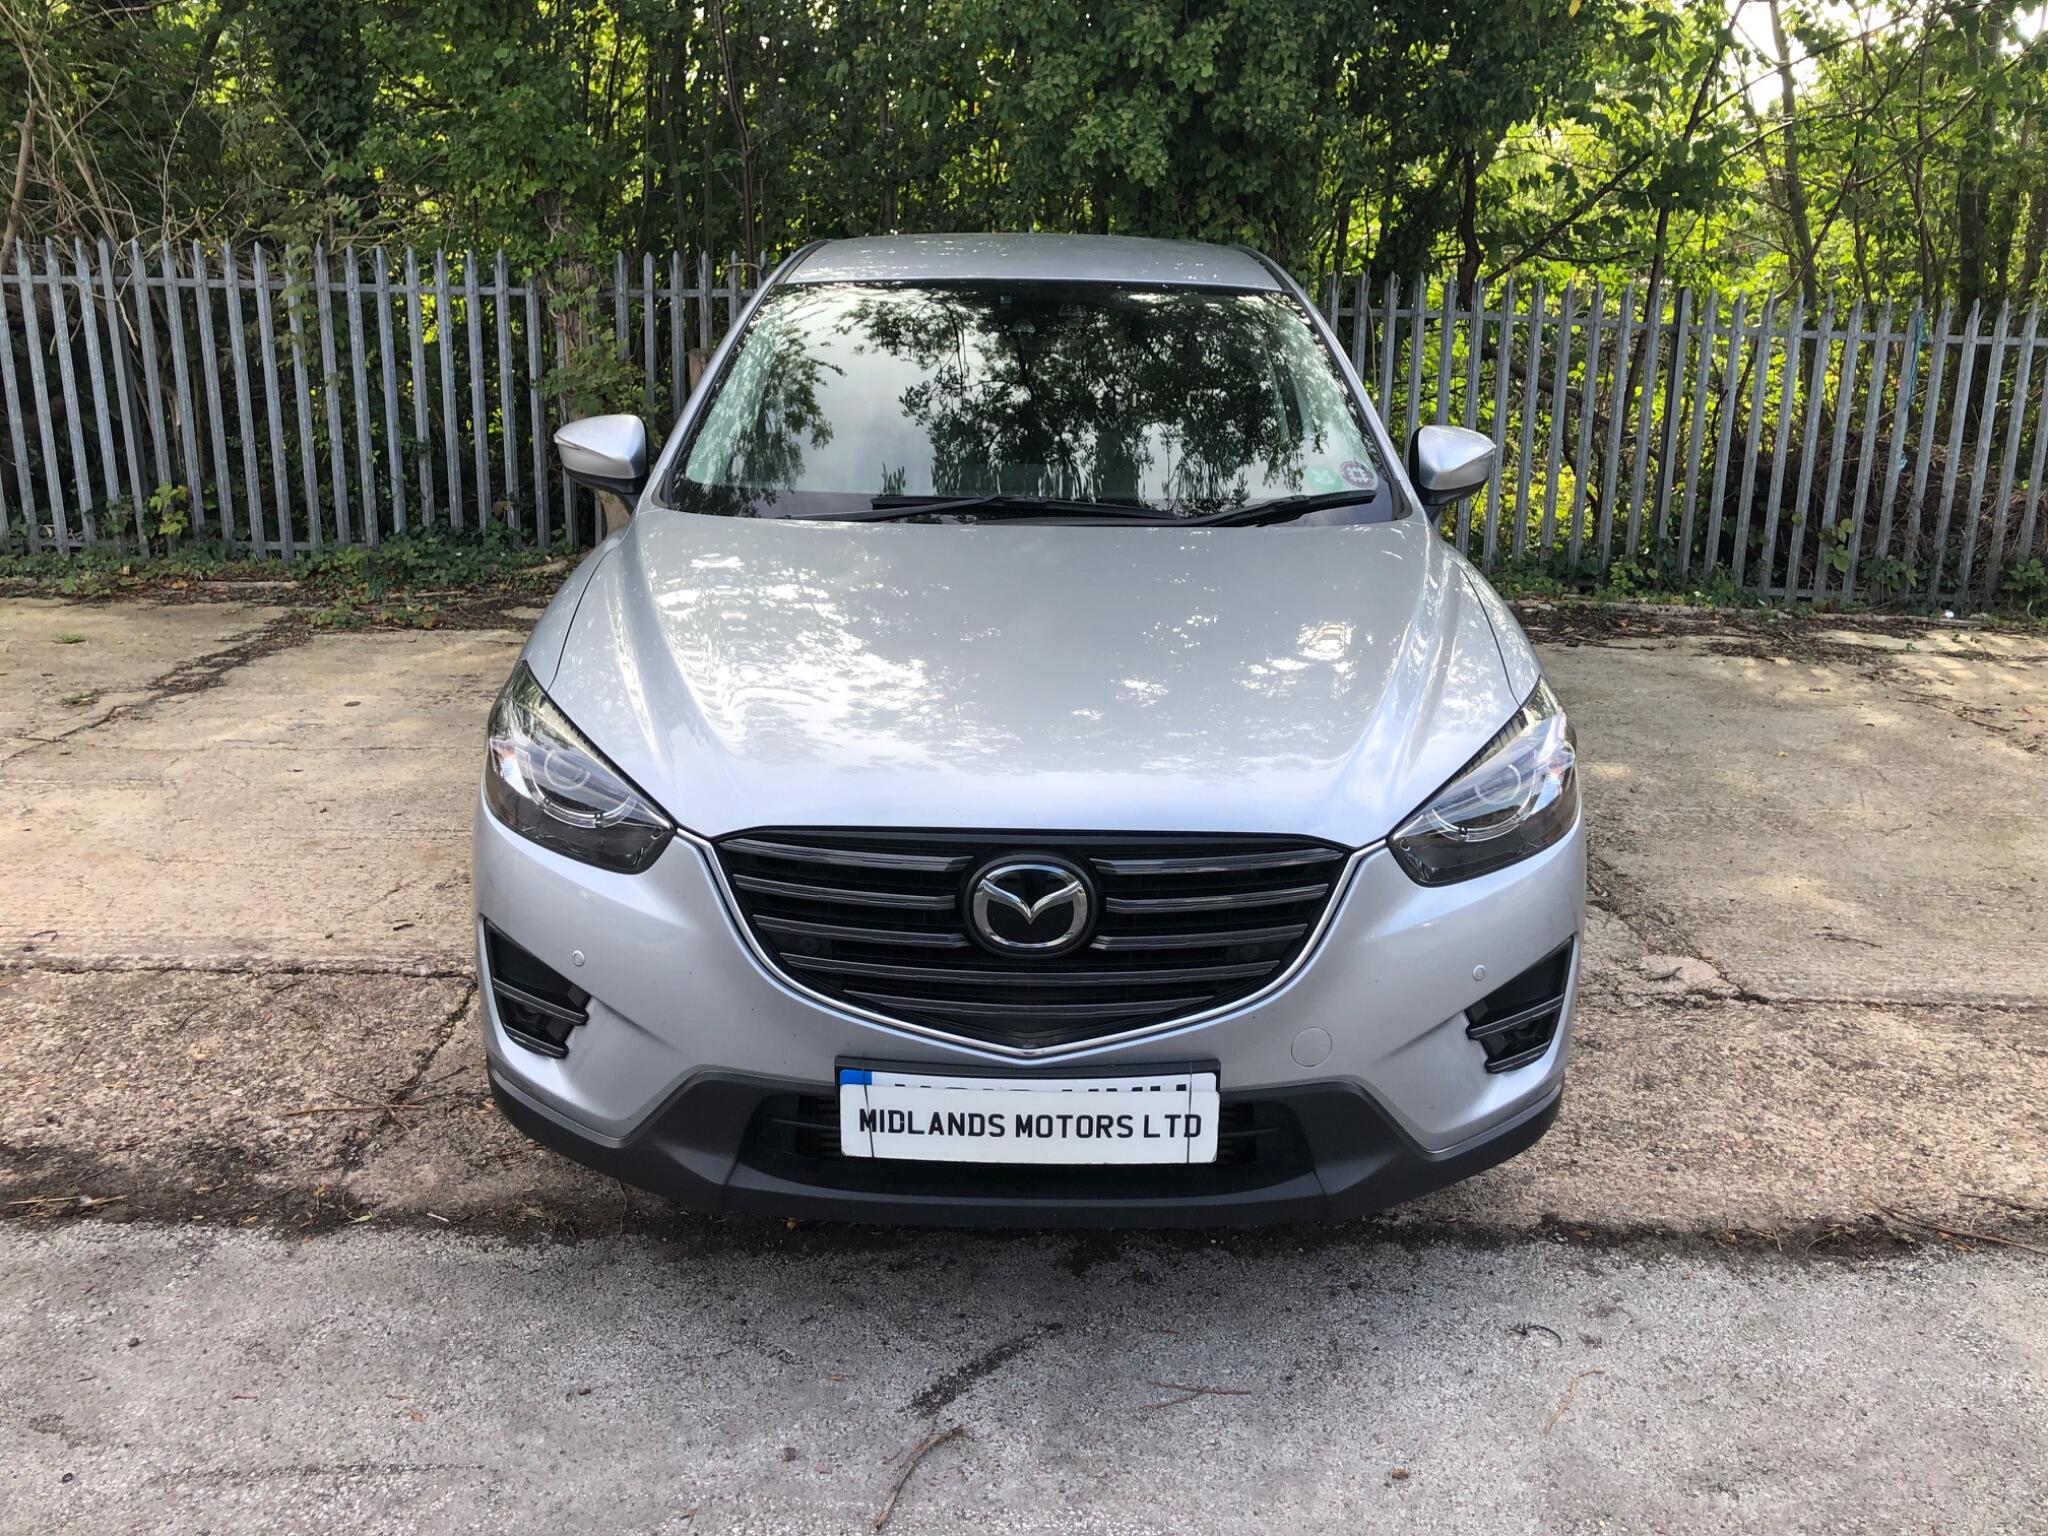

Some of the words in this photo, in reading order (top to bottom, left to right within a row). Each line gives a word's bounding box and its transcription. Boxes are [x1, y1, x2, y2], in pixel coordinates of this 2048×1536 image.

[859, 1108, 1006, 1138] MIDLANDS
[1015, 1114, 1133, 1139] MOTORS
[1143, 1114, 1202, 1138] LTD
